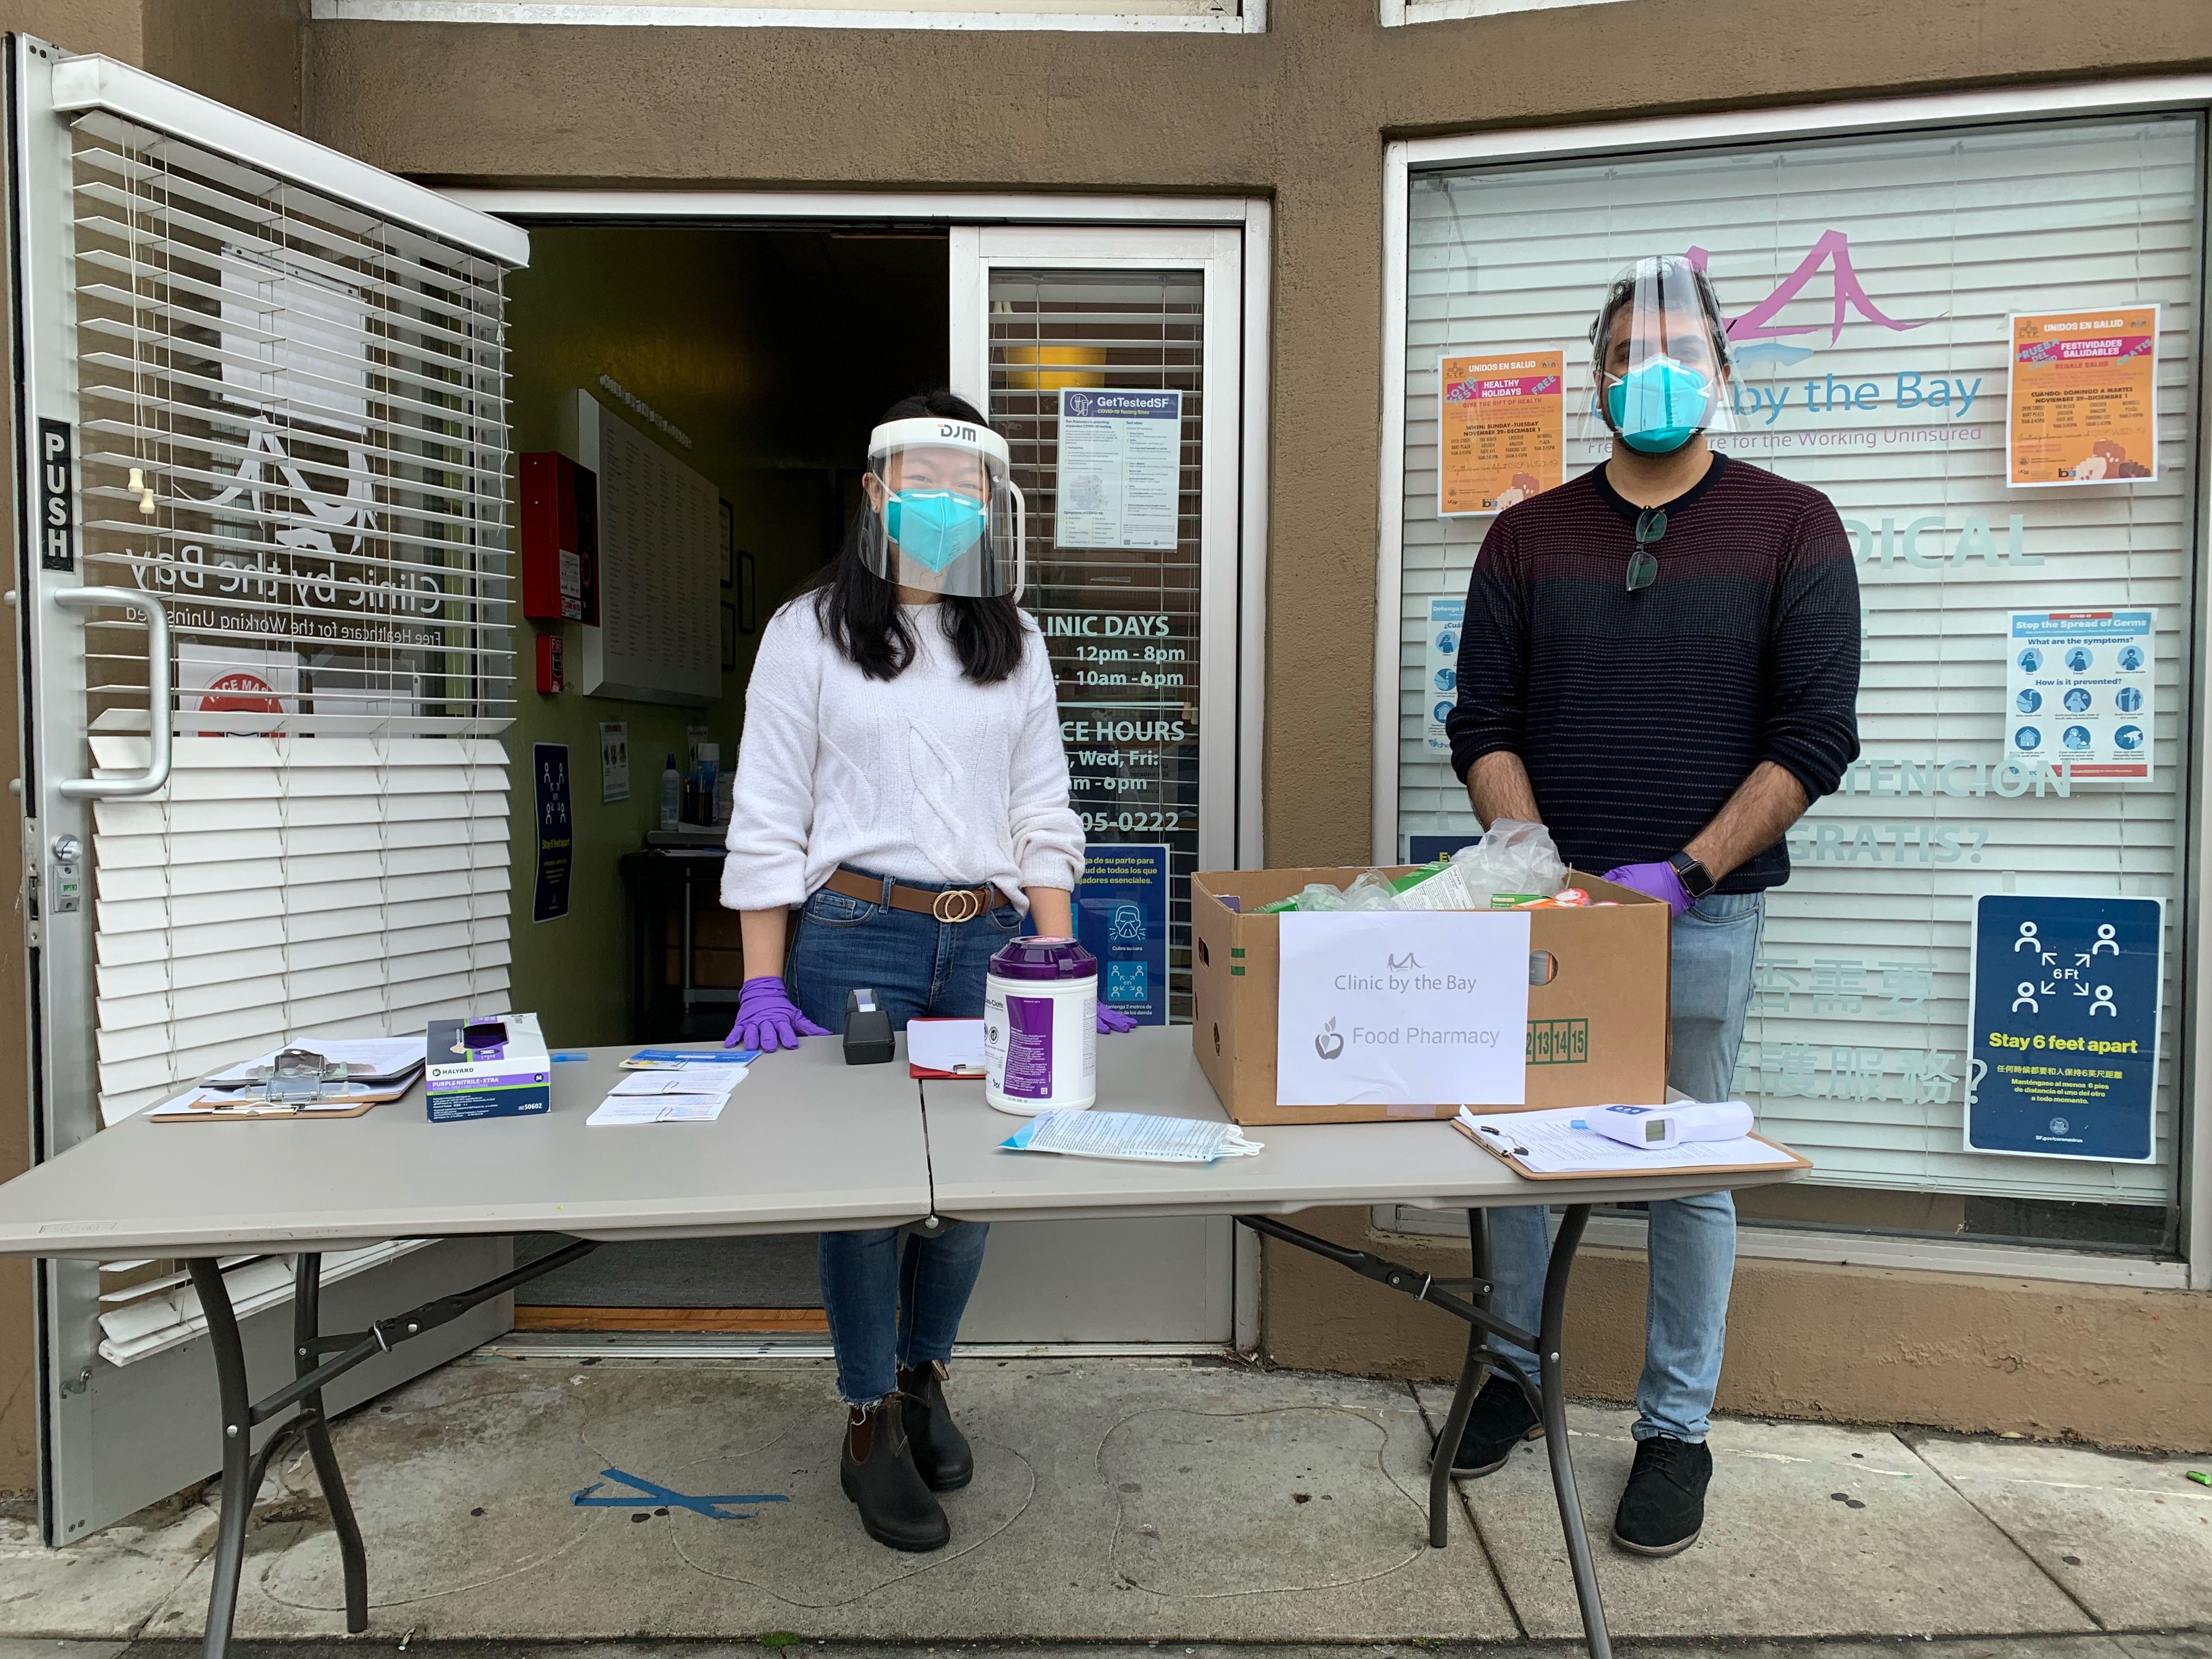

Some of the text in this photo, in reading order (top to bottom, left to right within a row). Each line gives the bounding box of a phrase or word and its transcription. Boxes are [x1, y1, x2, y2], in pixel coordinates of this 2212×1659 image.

[2044, 323, 2078, 332] UNIDOS
[2093, 319, 2124, 329] SALUD
[2061, 340, 2122, 351] FESTIVIDADES
[2064, 347, 2119, 358] SALUDABLES
[1469, 363, 1498, 373] UNIDOS
[1510, 361, 1536, 369] SALUD
[1482, 388, 1521, 397] HOLIDAYS
[1483, 380, 1519, 388] HEALTHY
[1531, 374, 1557, 395] FREE
[1733, 371, 1983, 426] by the Bay
[1733, 426, 1982, 449] for the Working Uninsured
[45, 432, 68, 558] PUSH
[1839, 514, 2045, 569] DICAL
[1105, 616, 1169, 636] DAYS
[2016, 618, 2146, 630] Stop the Spread of Germs
[2083, 637, 2134, 646] symptoms?
[1076, 646, 1185, 664] 12pm 8pm
[1076, 670, 1183, 689] 10am 6pm
[2073, 678, 2122, 686] prevented?
[1096, 721, 1184, 742] HOURS
[1078, 750, 1159, 768] Wed, Fri:
[1786, 824, 1989, 864] GRATIS?
[1115, 857, 1136, 865] parte
[2053, 969, 2079, 980] 6 Ft
[1334, 974, 1477, 994] Clinic by the Bay
[1353, 1027, 1500, 1048] Food Pharmacy
[1537, 1031, 1549, 1054] 13
[1554, 1030, 1567, 1054] 14
[1571, 1030, 1584, 1054] 15
[1989, 1032, 2138, 1055] Stay 6 feet apart
[2011, 1078, 2054, 1087] Manténgase
